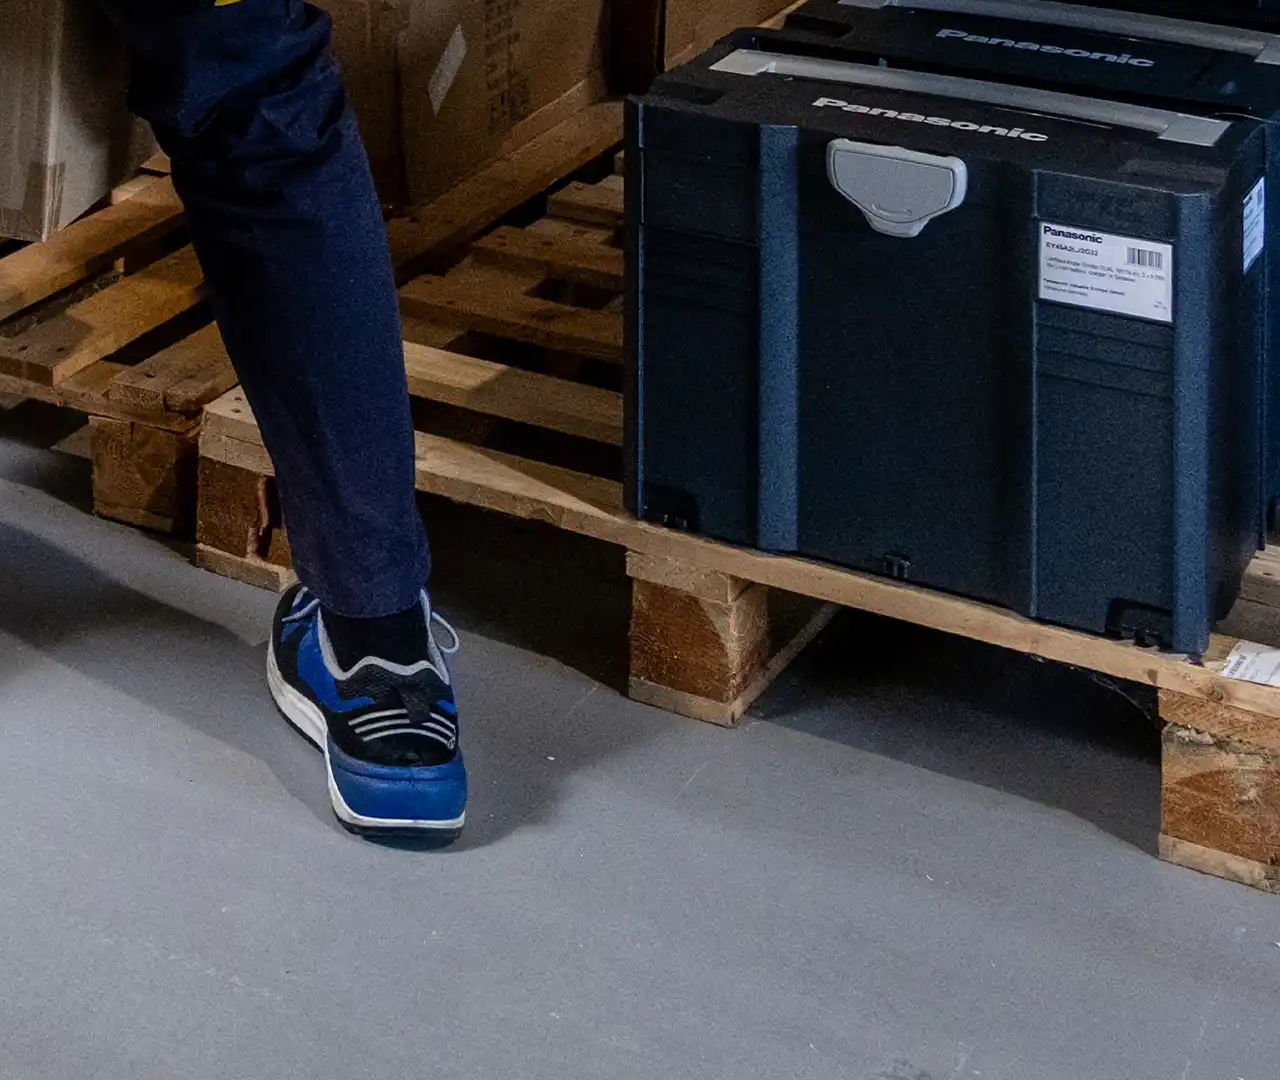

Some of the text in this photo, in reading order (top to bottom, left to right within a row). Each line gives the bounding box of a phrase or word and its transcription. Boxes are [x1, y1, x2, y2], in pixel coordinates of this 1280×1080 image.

[936, 28, 1155, 68] Panasonic
[812, 97, 1049, 142] Panasonic
[1043, 225, 1103, 243] Panasonic
